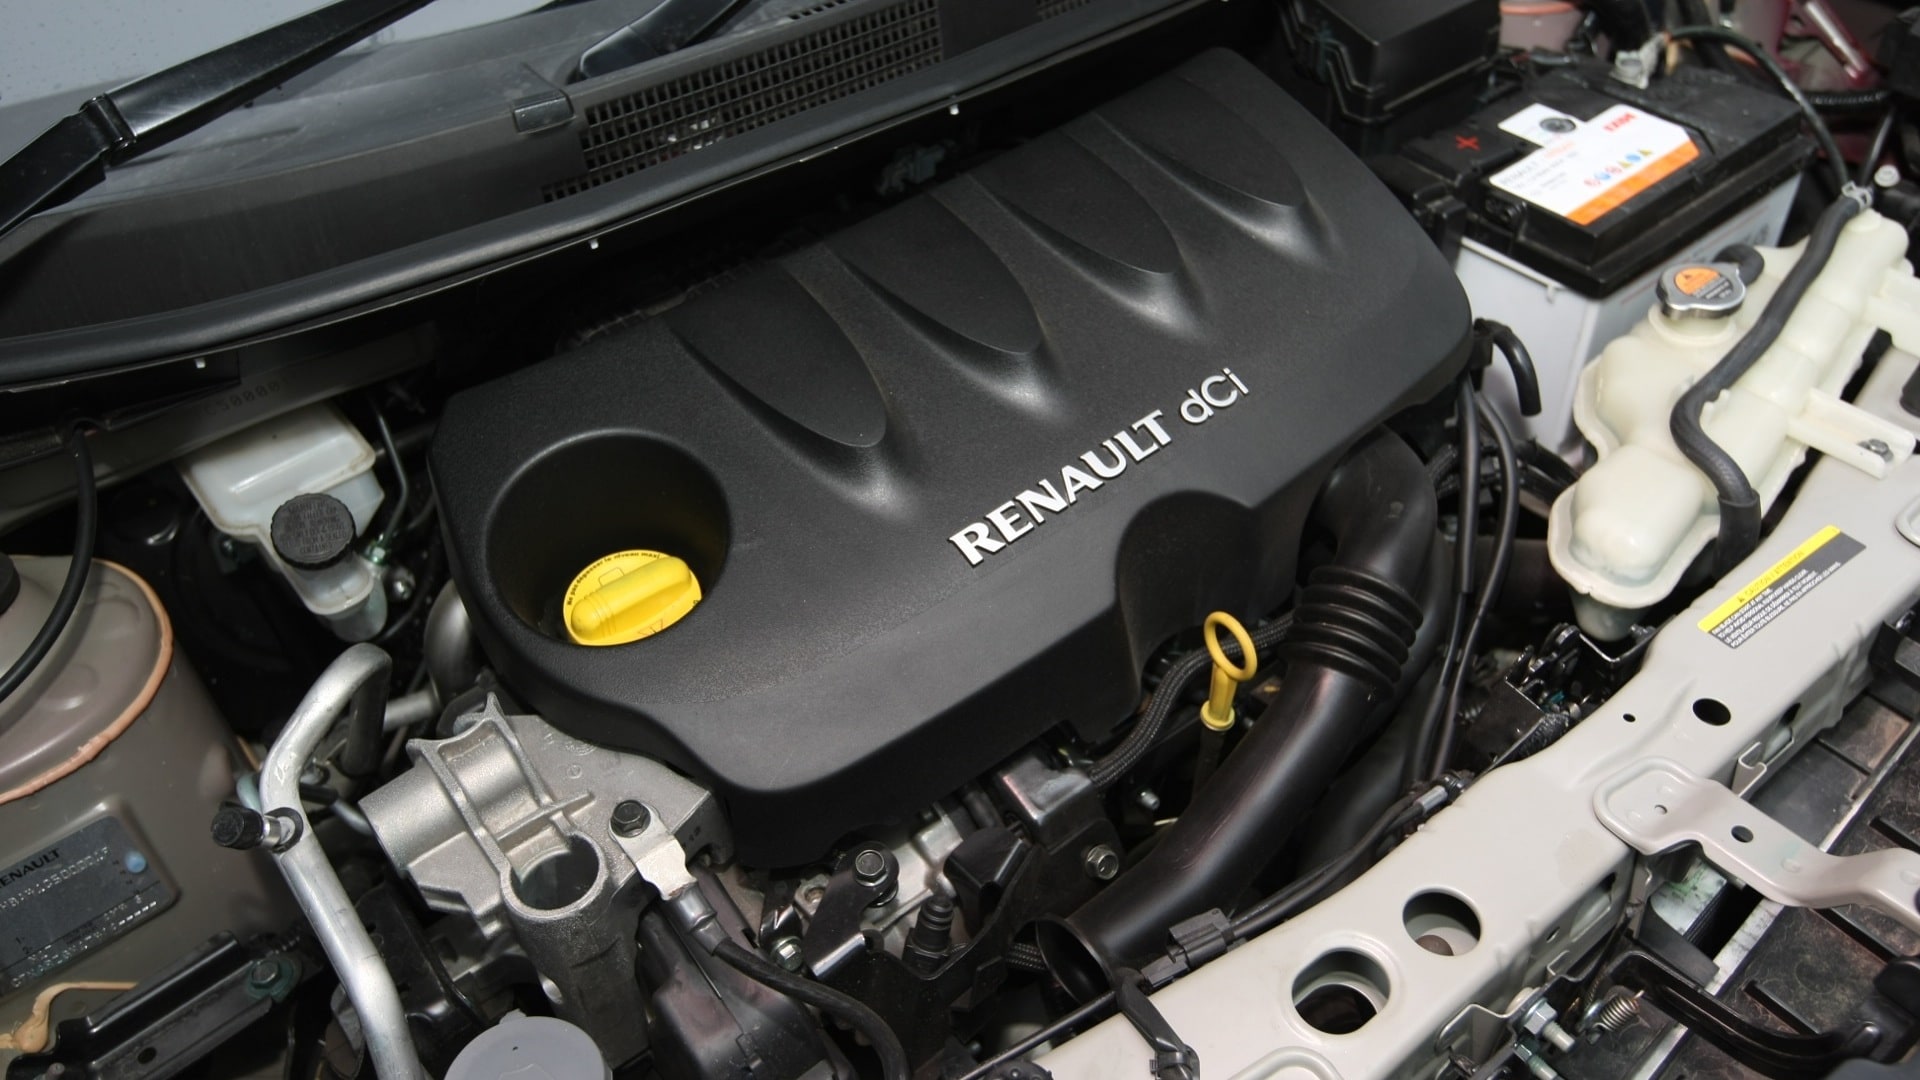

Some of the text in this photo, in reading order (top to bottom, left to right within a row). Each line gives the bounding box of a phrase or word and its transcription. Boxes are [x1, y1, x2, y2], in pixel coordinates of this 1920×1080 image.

[948, 366, 1250, 567] RENAULT dCi
[0, 847, 60, 889] ENAULT
